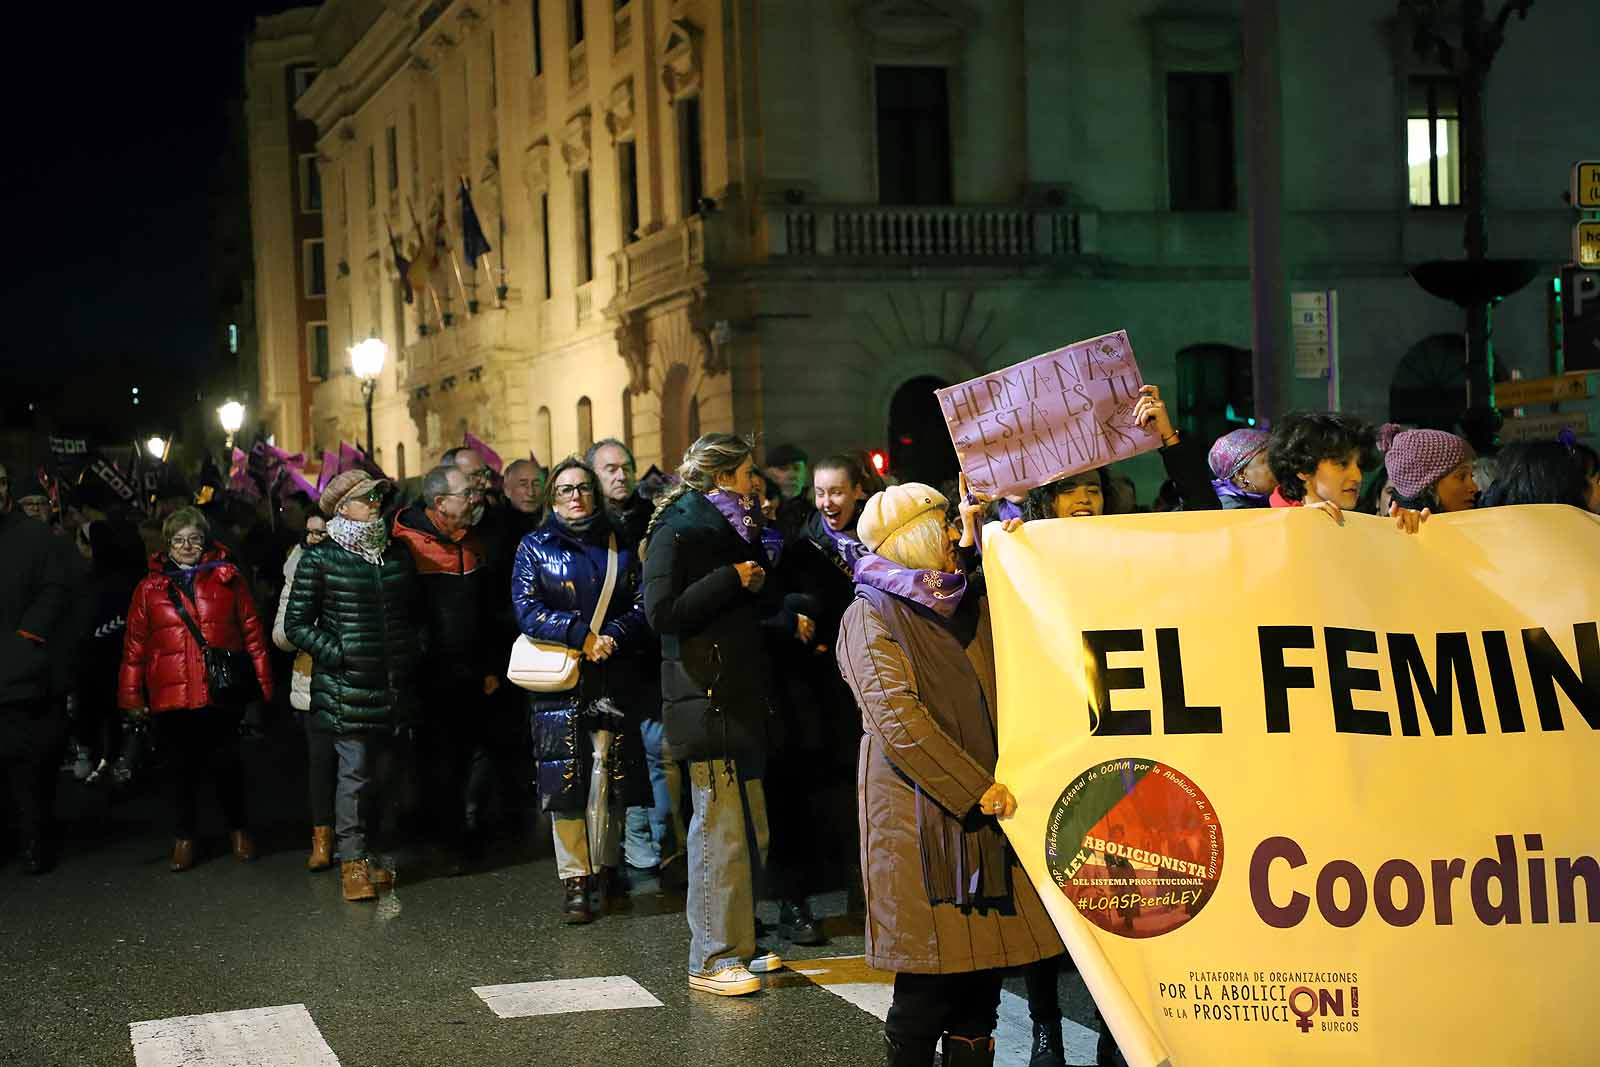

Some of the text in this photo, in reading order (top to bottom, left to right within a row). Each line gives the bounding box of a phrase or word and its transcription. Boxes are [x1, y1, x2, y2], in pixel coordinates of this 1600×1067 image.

[1061, 383, 1095, 417] ES
[1101, 371, 1143, 405] TU
[1082, 621, 1600, 737] EL FEMIN
[1088, 771, 1098, 781] de
[1100, 761, 1130, 775] OOMM
[1133, 763, 1150, 772] por
[1152, 765, 1161, 775] la
[1061, 778, 1086, 807] Estatal
[1162, 770, 1198, 799] Abolición
[1195, 799, 1205, 810] de
[1202, 812, 1212, 821] la
[1048, 807, 1065, 857] Plataforma
[1082, 835, 1207, 879] ABOLICIONISTA
[1207, 823, 1220, 880] Prostitución
[1063, 849, 1088, 880] LEY
[1052, 868, 1066, 888] PAP
[1072, 878, 1204, 887] DEL SISTEMA PROSTITUCIONAL
[1248, 833, 1600, 930] Coordin
[1077, 888, 1203, 911] #LOASPseráLEY
[1189, 971, 1359, 984] PLATAFORMA DE ORGANIZACIONES
[1159, 982, 1187, 1000] POR
[1194, 984, 1214, 1001] LA
[1163, 1007, 1174, 1018] DE
[1177, 1008, 1188, 1019] LA
[1321, 1021, 1360, 1033] BURGOS
